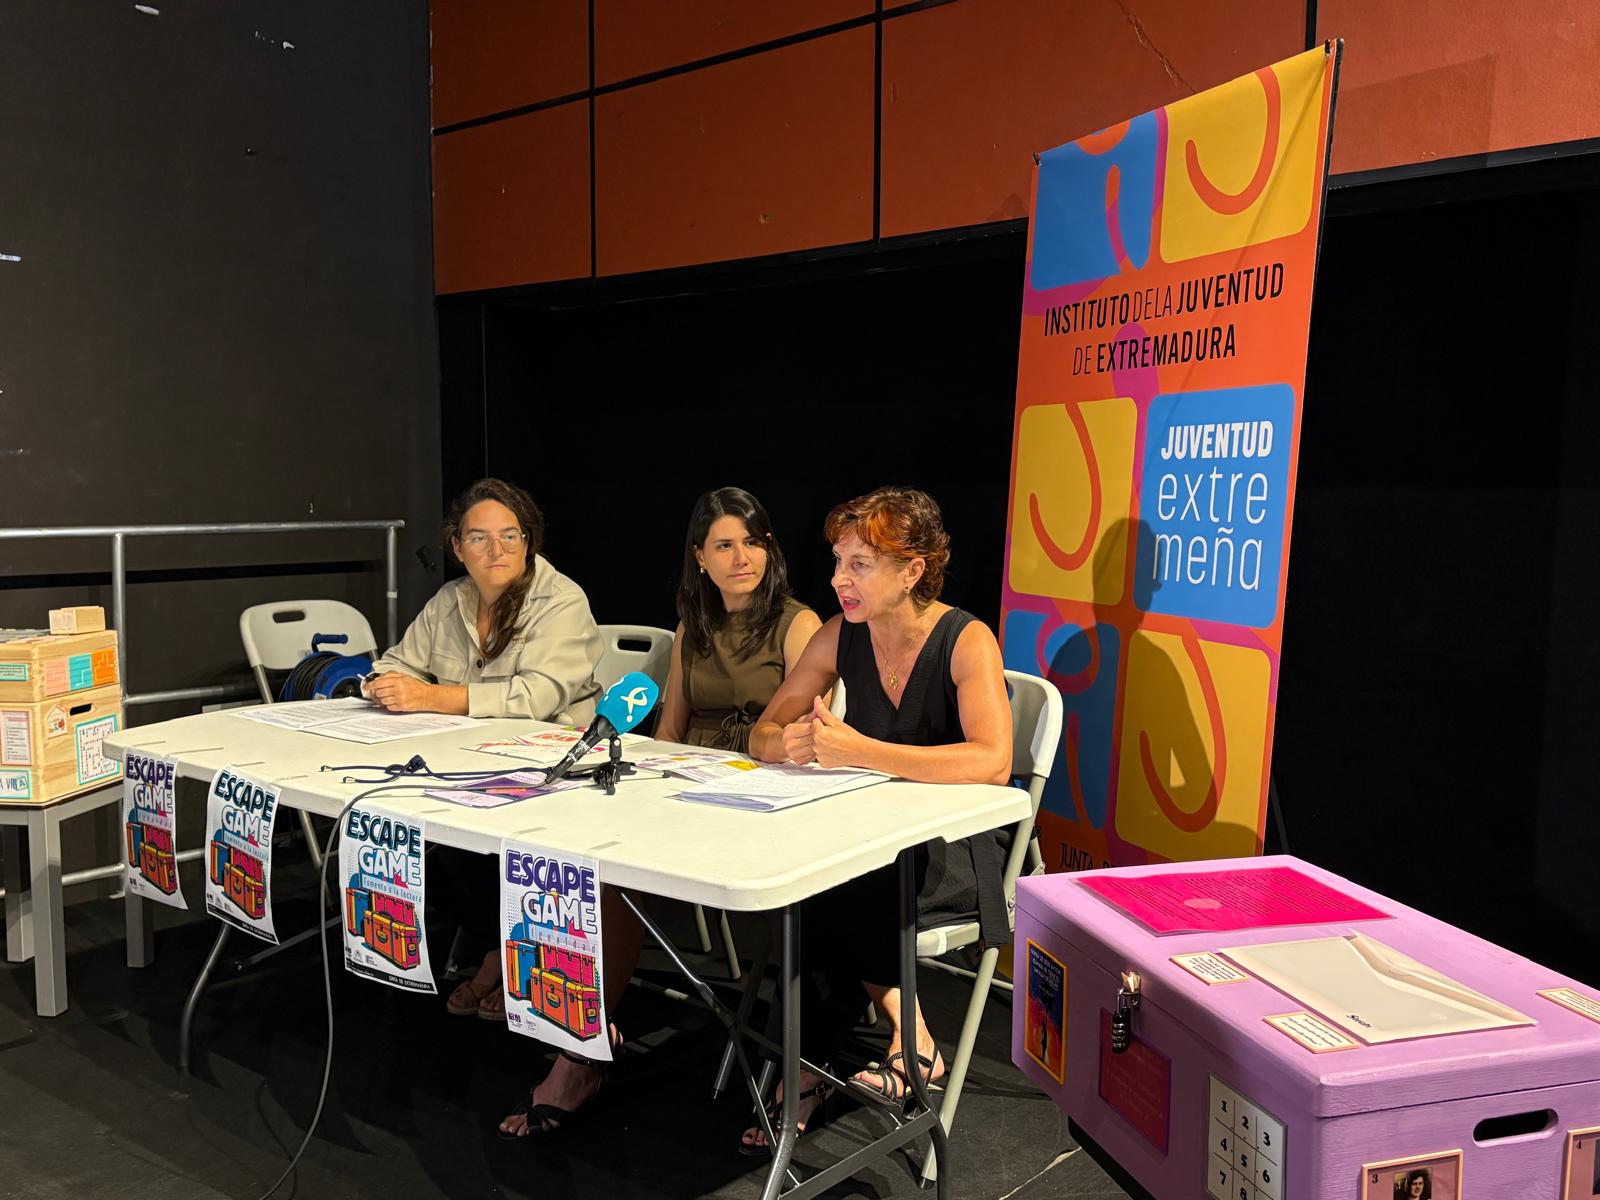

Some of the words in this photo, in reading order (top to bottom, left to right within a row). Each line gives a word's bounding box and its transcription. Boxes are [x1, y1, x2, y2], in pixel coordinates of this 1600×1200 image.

[1044, 294, 1129, 336] INSTITUTO
[1176, 263, 1284, 315] JUVENTUD
[1073, 345, 1092, 376] DE
[1097, 324, 1236, 373] EXTREMADURA
[1161, 420, 1273, 460] JUVENTUD
[1158, 466, 1268, 525] extre
[1153, 527, 1262, 591] meña
[126, 754, 174, 790] ESCAPE
[133, 783, 173, 814] GAME
[214, 770, 275, 822] ESCAPE
[222, 805, 273, 847] GAME
[346, 808, 421, 859] ESCAPE
[358, 845, 421, 887] GAME
[506, 850, 596, 904] ESCAPE
[523, 891, 598, 934] GAME
[1221, 1100, 1228, 1113] 1
[1242, 1115, 1249, 1130] 2
[1263, 1131, 1271, 1147] 3
[1575, 1140, 1582, 1150] 4
[1220, 1138, 1227, 1151] 4
[1241, 1153, 1248, 1168] 5
[1262, 1169, 1270, 1183] 6
[1371, 1173, 1379, 1184] 3
[1219, 1170, 1226, 1185] 7
[1240, 1187, 1247, 1200] 8
